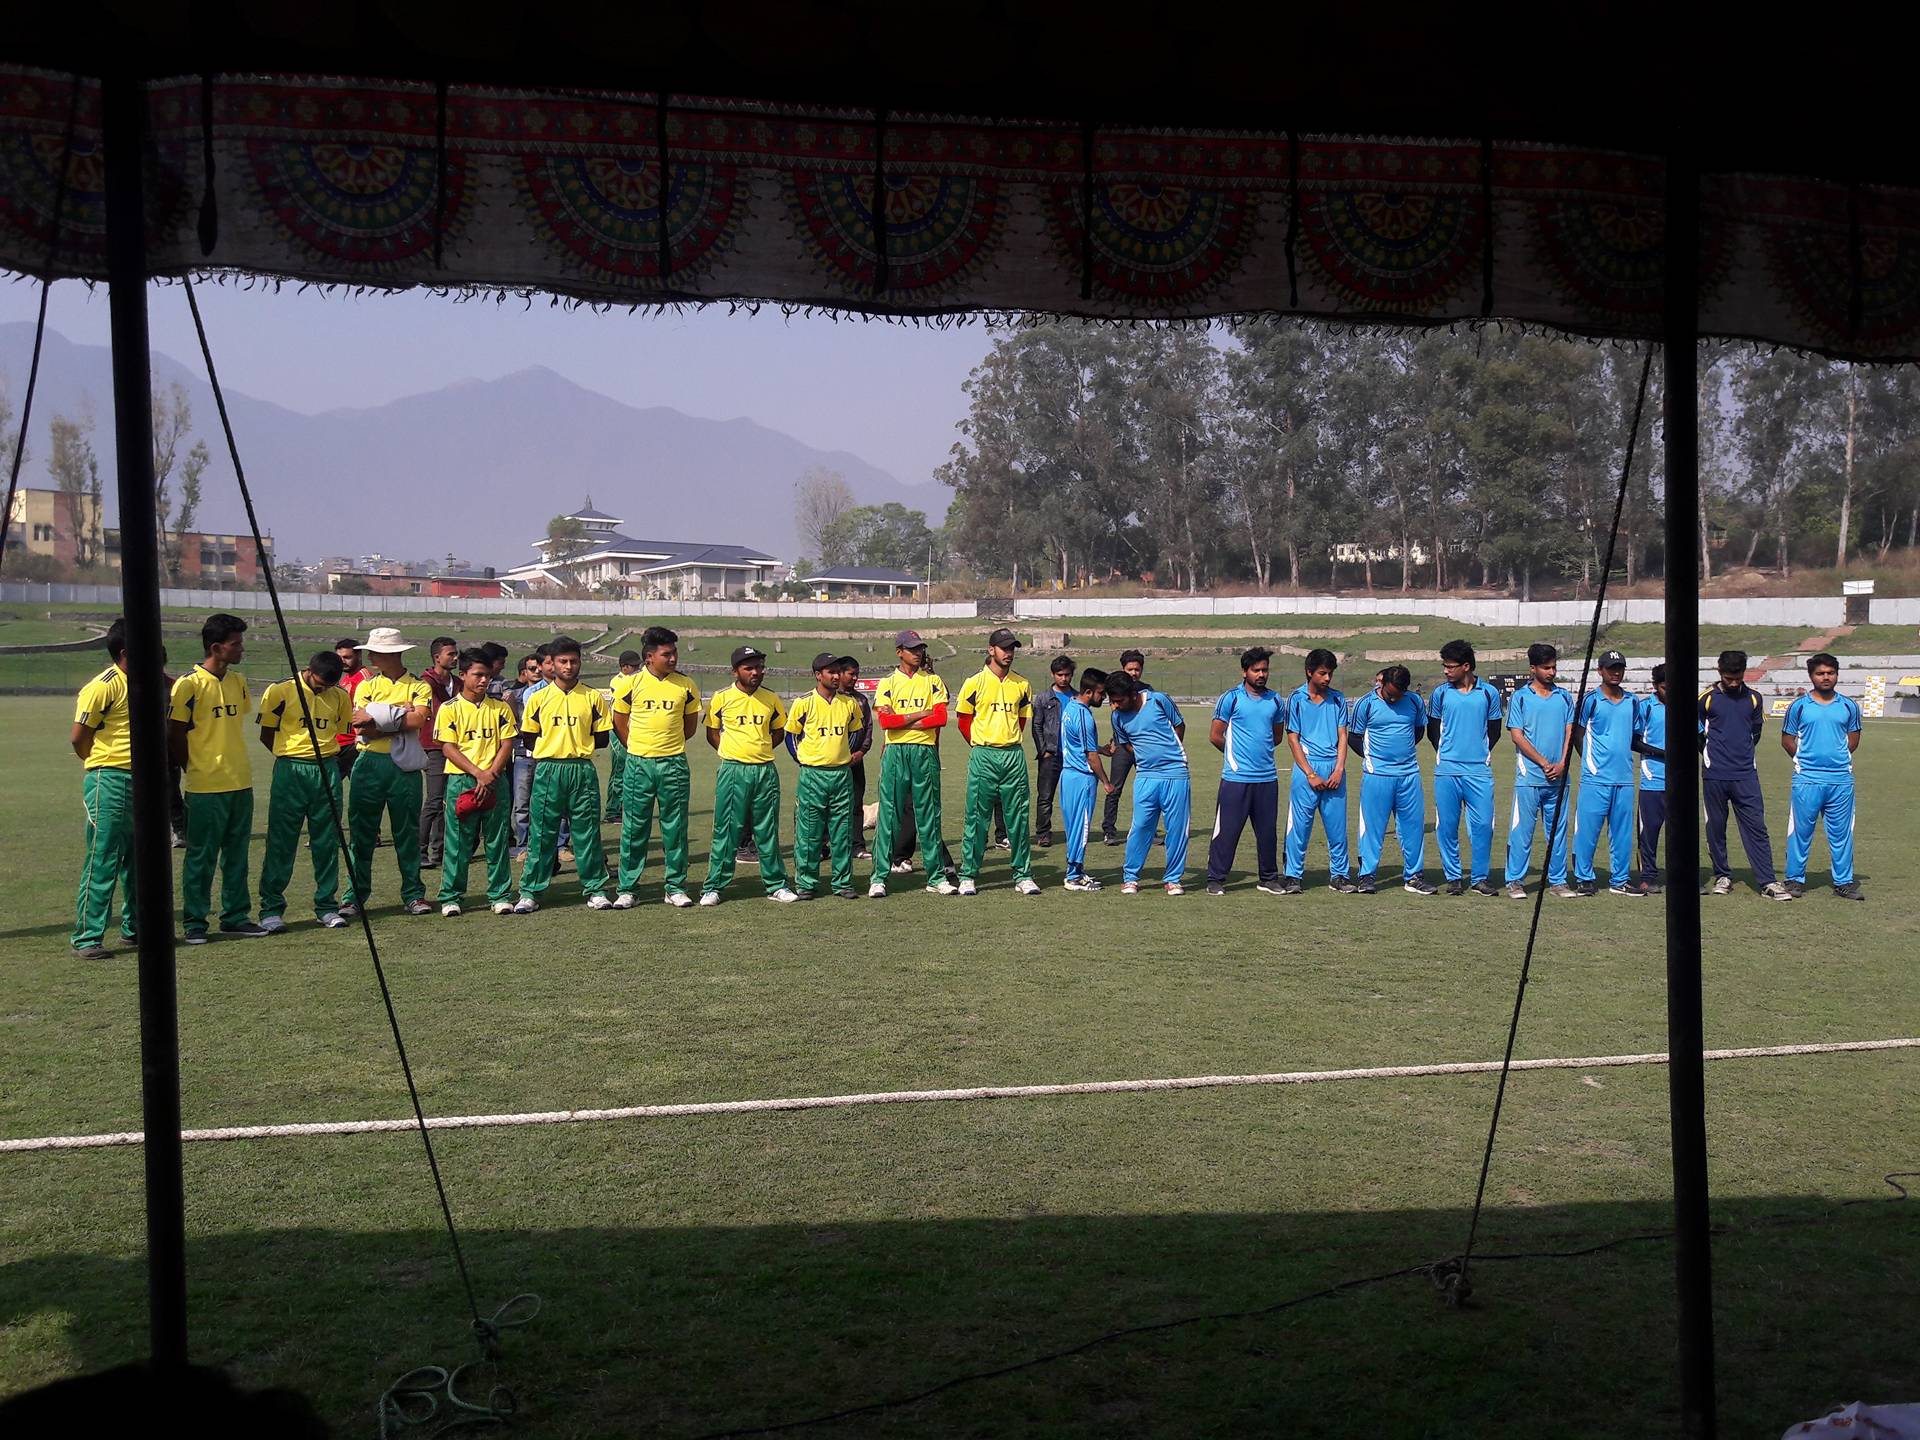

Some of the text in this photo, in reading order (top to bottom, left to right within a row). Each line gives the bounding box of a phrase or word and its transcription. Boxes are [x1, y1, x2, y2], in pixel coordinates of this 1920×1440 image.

[643, 700, 674, 711] T.U
[898, 698, 924, 709] T.U
[991, 703, 1013, 713] T.U
[552, 716, 577, 727] T.U
[736, 715, 765, 726] T.U
[465, 728, 494, 740] T.U
[818, 726, 845, 737] T.U
